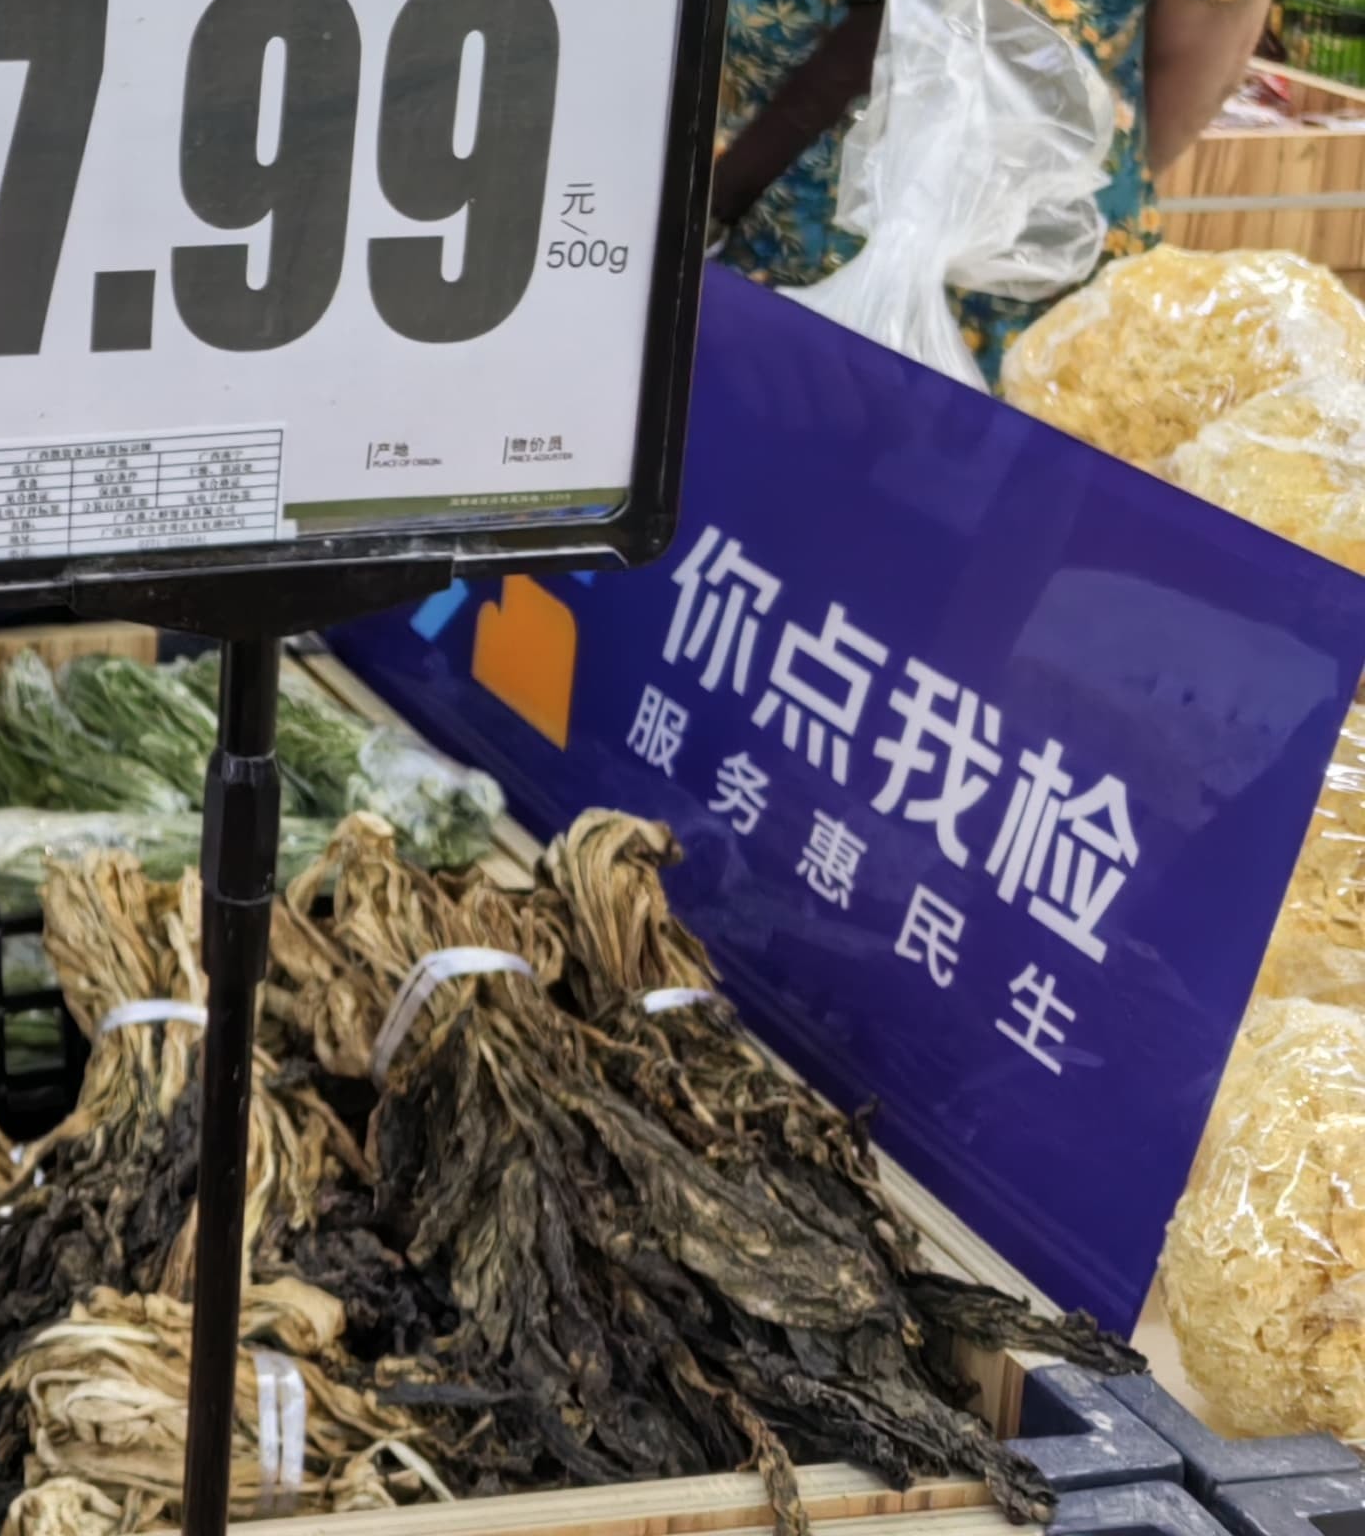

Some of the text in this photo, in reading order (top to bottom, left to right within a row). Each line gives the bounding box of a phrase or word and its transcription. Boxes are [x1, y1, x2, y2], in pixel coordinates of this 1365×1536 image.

[560, 183, 595, 216] 元
[546, 239, 628, 274] 500g
[374, 442, 409, 458] 产地
[662, 525, 1139, 964] 你点我检
[627, 685, 1076, 1075] 服务惠民生
